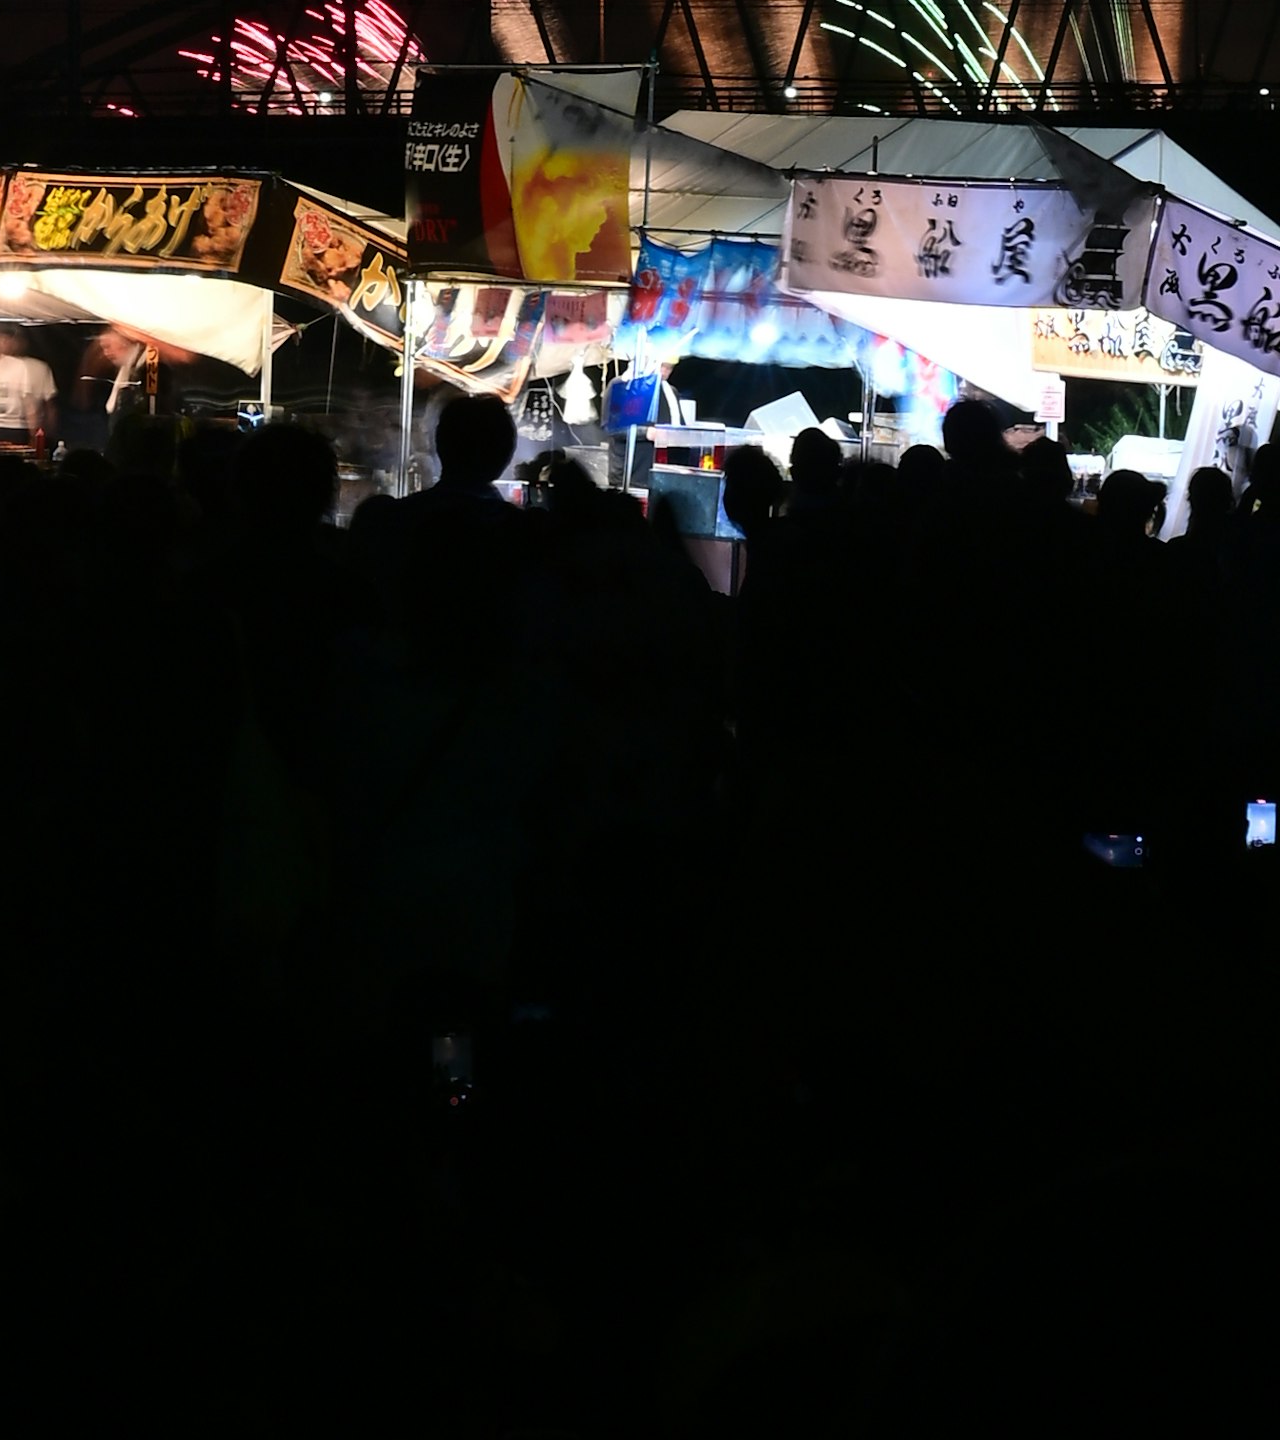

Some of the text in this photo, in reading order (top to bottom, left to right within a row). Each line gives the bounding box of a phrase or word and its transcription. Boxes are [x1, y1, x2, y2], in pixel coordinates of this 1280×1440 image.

[70, 182, 213, 256] からあげ
[828, 208, 1036, 285] 黒船屋
